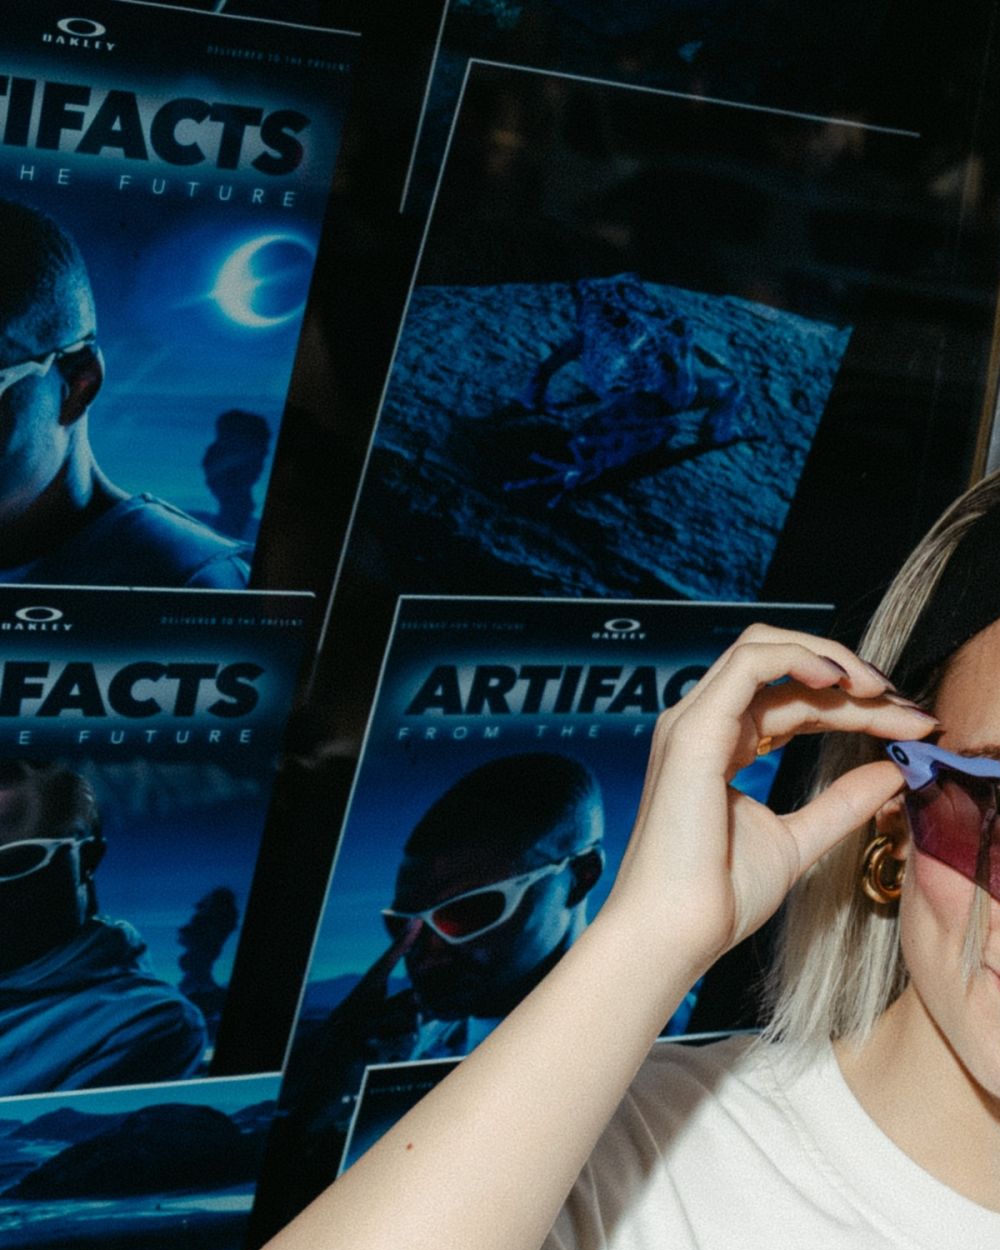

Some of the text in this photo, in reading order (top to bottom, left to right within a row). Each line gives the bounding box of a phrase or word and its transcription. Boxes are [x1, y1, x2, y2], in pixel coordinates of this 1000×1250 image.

[42, 33, 115, 51] OAKLEY
[119, 174, 296, 208] FUTURE
[0, 623, 73, 632] OAKLEY
[591, 632, 646, 640] OAKLEY
[0, 660, 265, 719] FACTS
[404, 664, 709, 717] ARTIFAC
[77, 729, 252, 746] FUTURE
[398, 724, 600, 741] FROM THE
